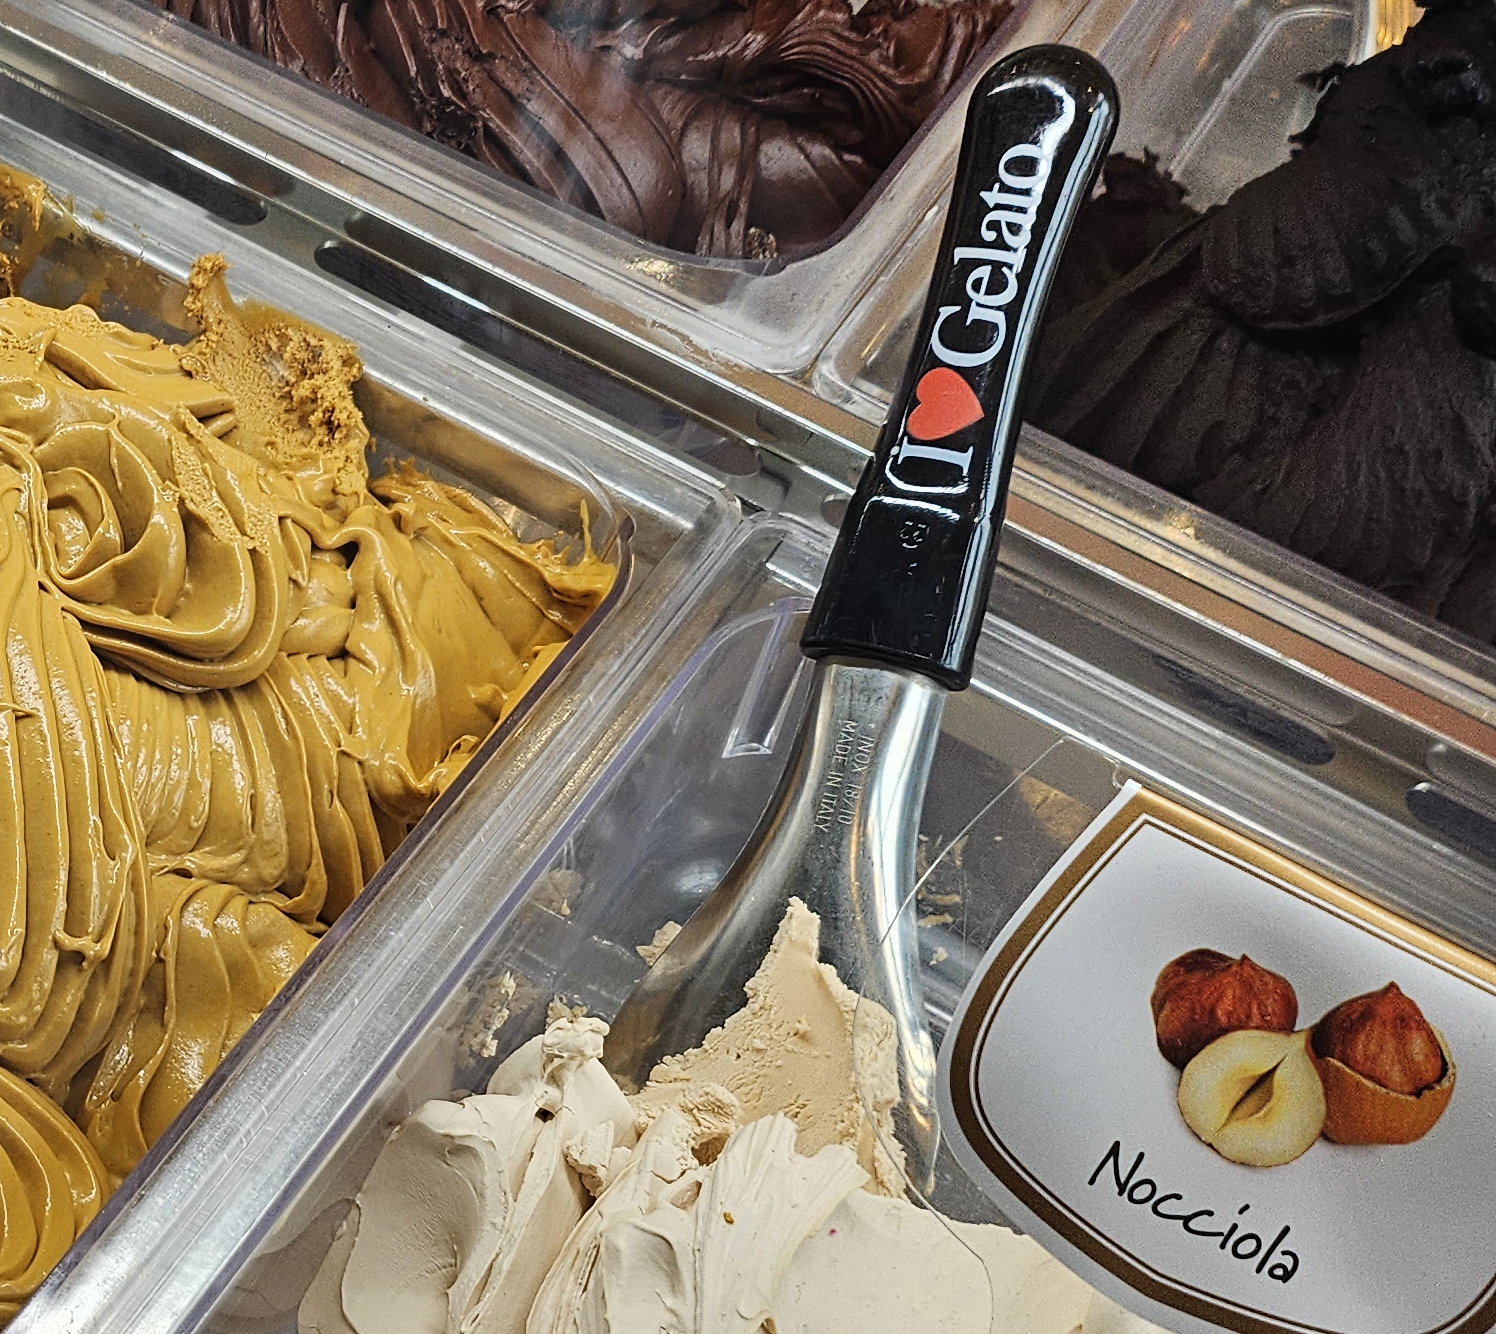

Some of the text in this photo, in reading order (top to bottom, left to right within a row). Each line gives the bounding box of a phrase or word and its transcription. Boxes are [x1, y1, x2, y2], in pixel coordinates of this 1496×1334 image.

[897, 142, 1046, 476] I Gelato
[814, 719, 858, 833] MADE IN ITALY
[837, 734, 875, 825] INOX 18/10
[1087, 1140, 1301, 1284] Nocciola
